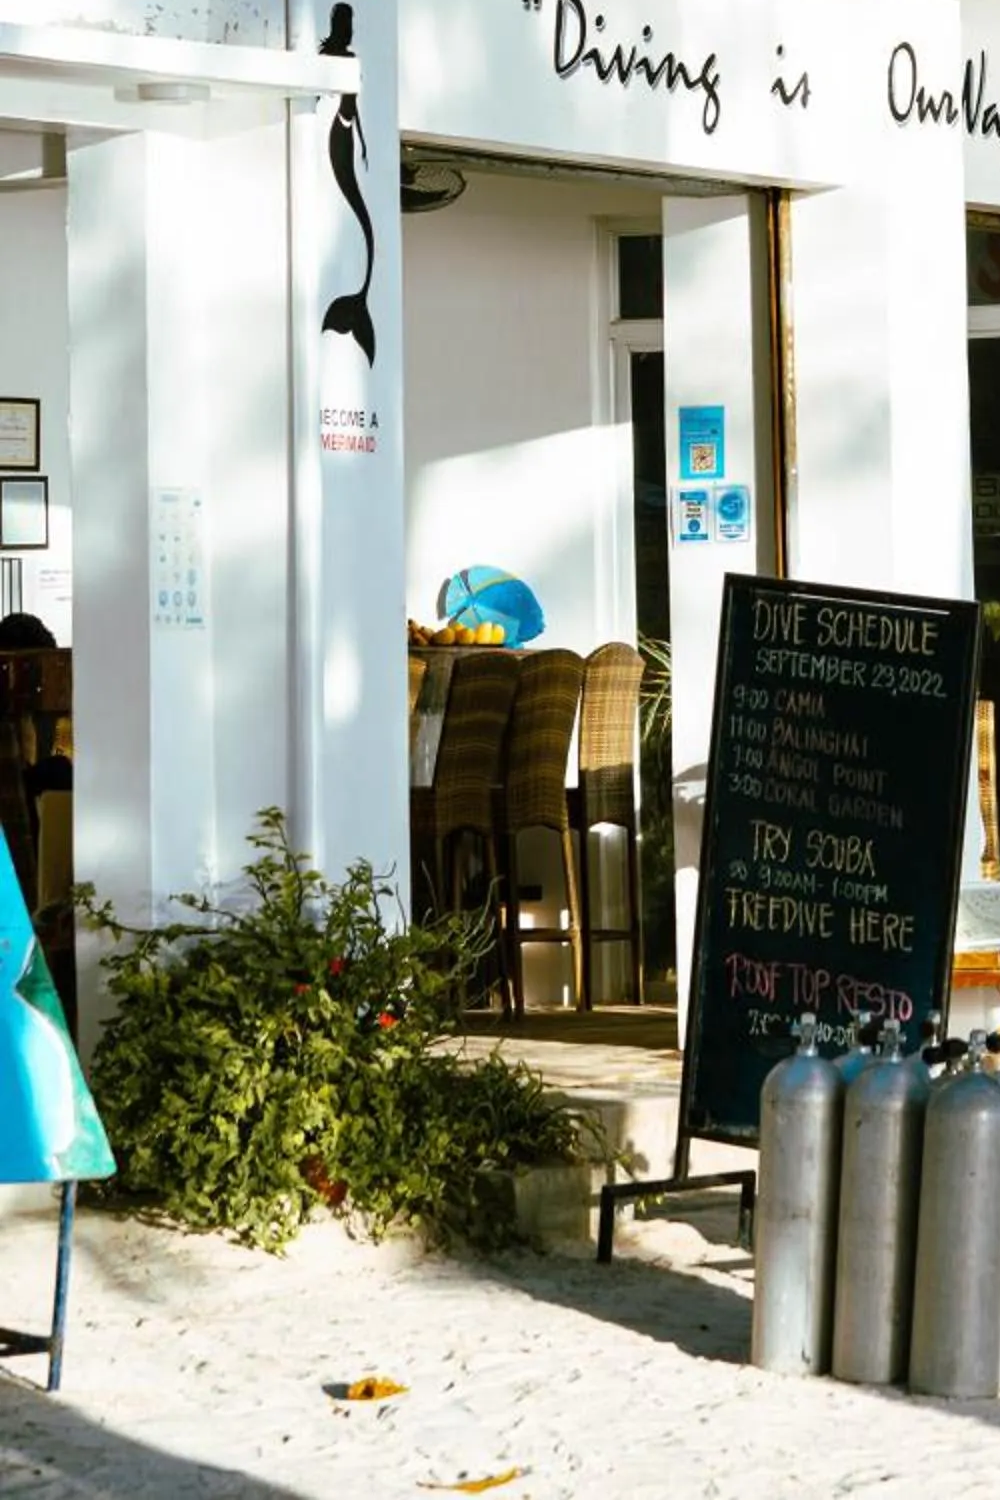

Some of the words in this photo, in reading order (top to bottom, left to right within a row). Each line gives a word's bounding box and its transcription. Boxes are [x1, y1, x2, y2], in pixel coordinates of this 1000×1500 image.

[772, 45, 812, 109] is
[887, 41, 959, 126] Our
[320, 409, 365, 427] ECOME
[370, 412, 379, 428] A
[753, 599, 807, 645] DIVE
[817, 607, 938, 656] SCHEDULE
[755, 648, 865, 688] SEPTEMBER
[833, 763, 889, 797] POINT
[750, 819, 793, 864] TRY
[806, 829, 876, 878] SCUBA
[725, 887, 834, 939] FREEDIVE
[849, 906, 915, 953] HERE
[836, 973, 914, 1022] RESTO
